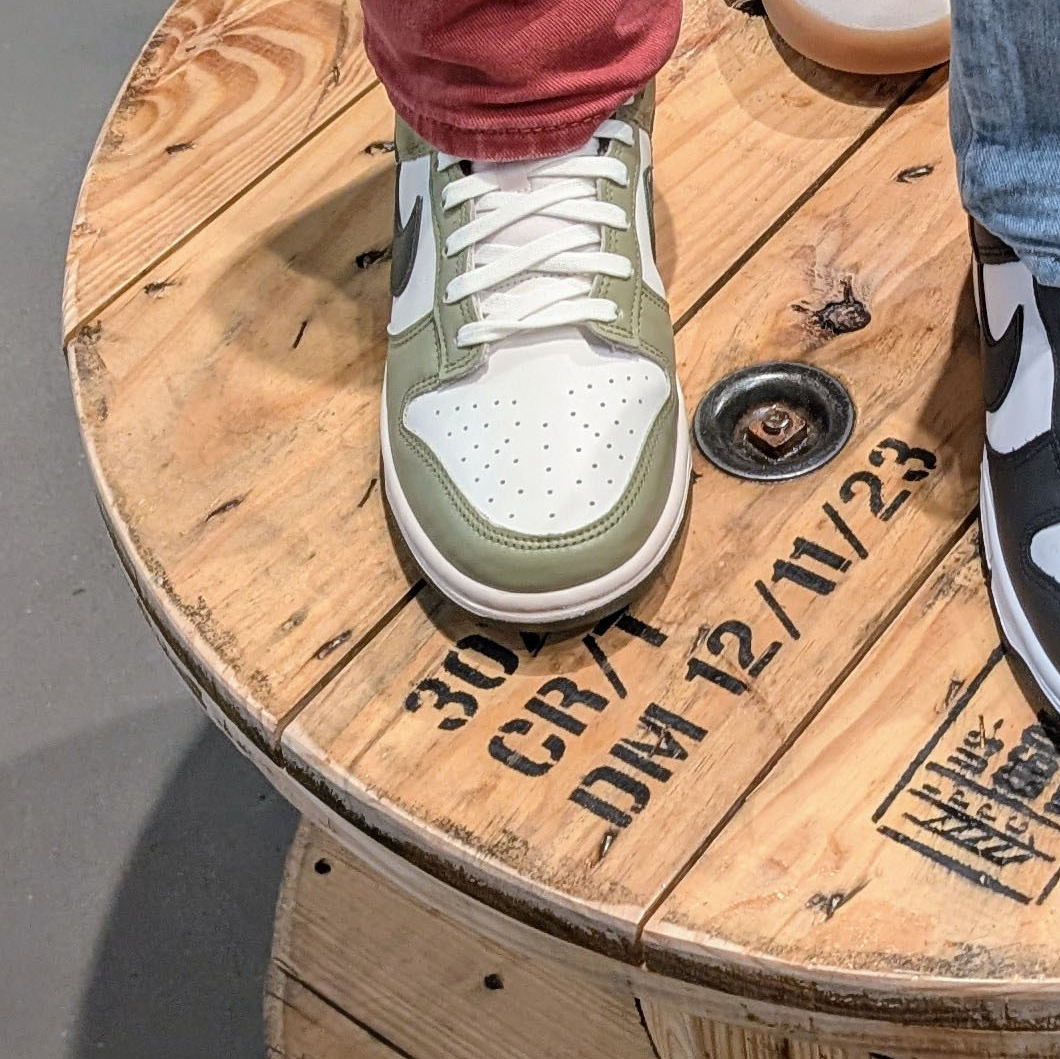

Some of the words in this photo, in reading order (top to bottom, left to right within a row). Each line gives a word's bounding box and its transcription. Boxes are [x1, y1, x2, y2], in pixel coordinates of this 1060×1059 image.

[488, 604, 668, 777] CR/T
[568, 702, 709, 828] DM
[685, 437, 937, 696] 12/11/23
